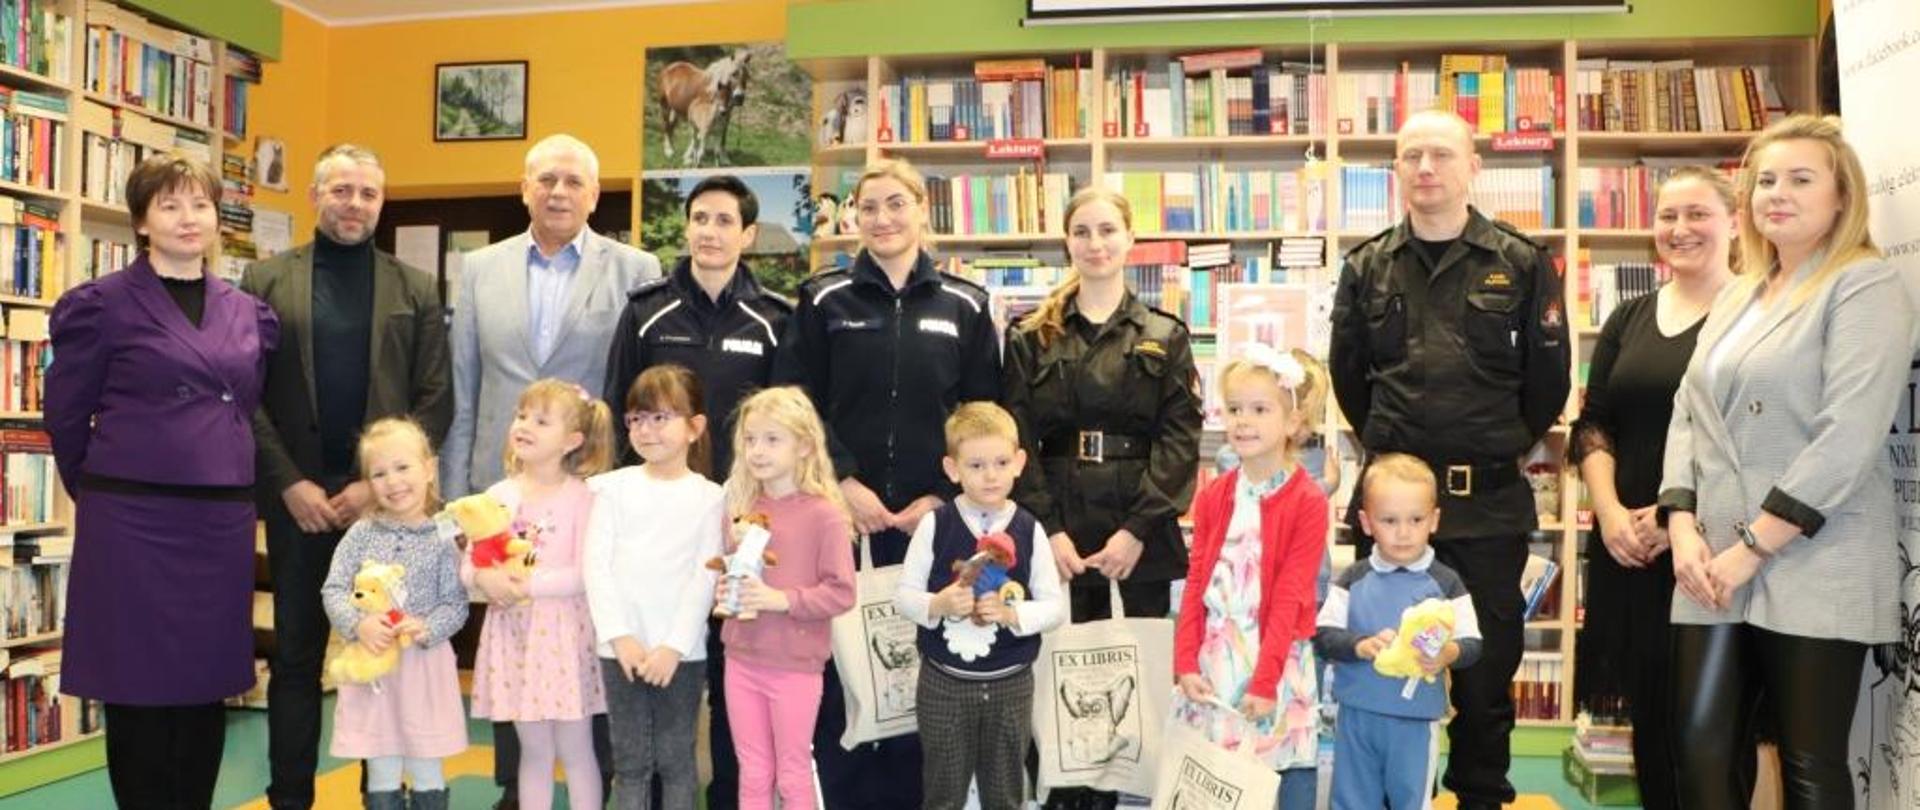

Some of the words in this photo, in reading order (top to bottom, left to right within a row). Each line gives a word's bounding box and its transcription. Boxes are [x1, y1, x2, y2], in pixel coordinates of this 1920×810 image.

[879, 129, 891, 141] A
[989, 143, 1038, 155] Lektury
[1495, 136, 1548, 149] Lektury
[868, 606, 886, 620] EX
[1058, 654, 1078, 666] EX
[1083, 650, 1132, 666] LIBRIS
[1195, 771, 1233, 803] LIBRIS
